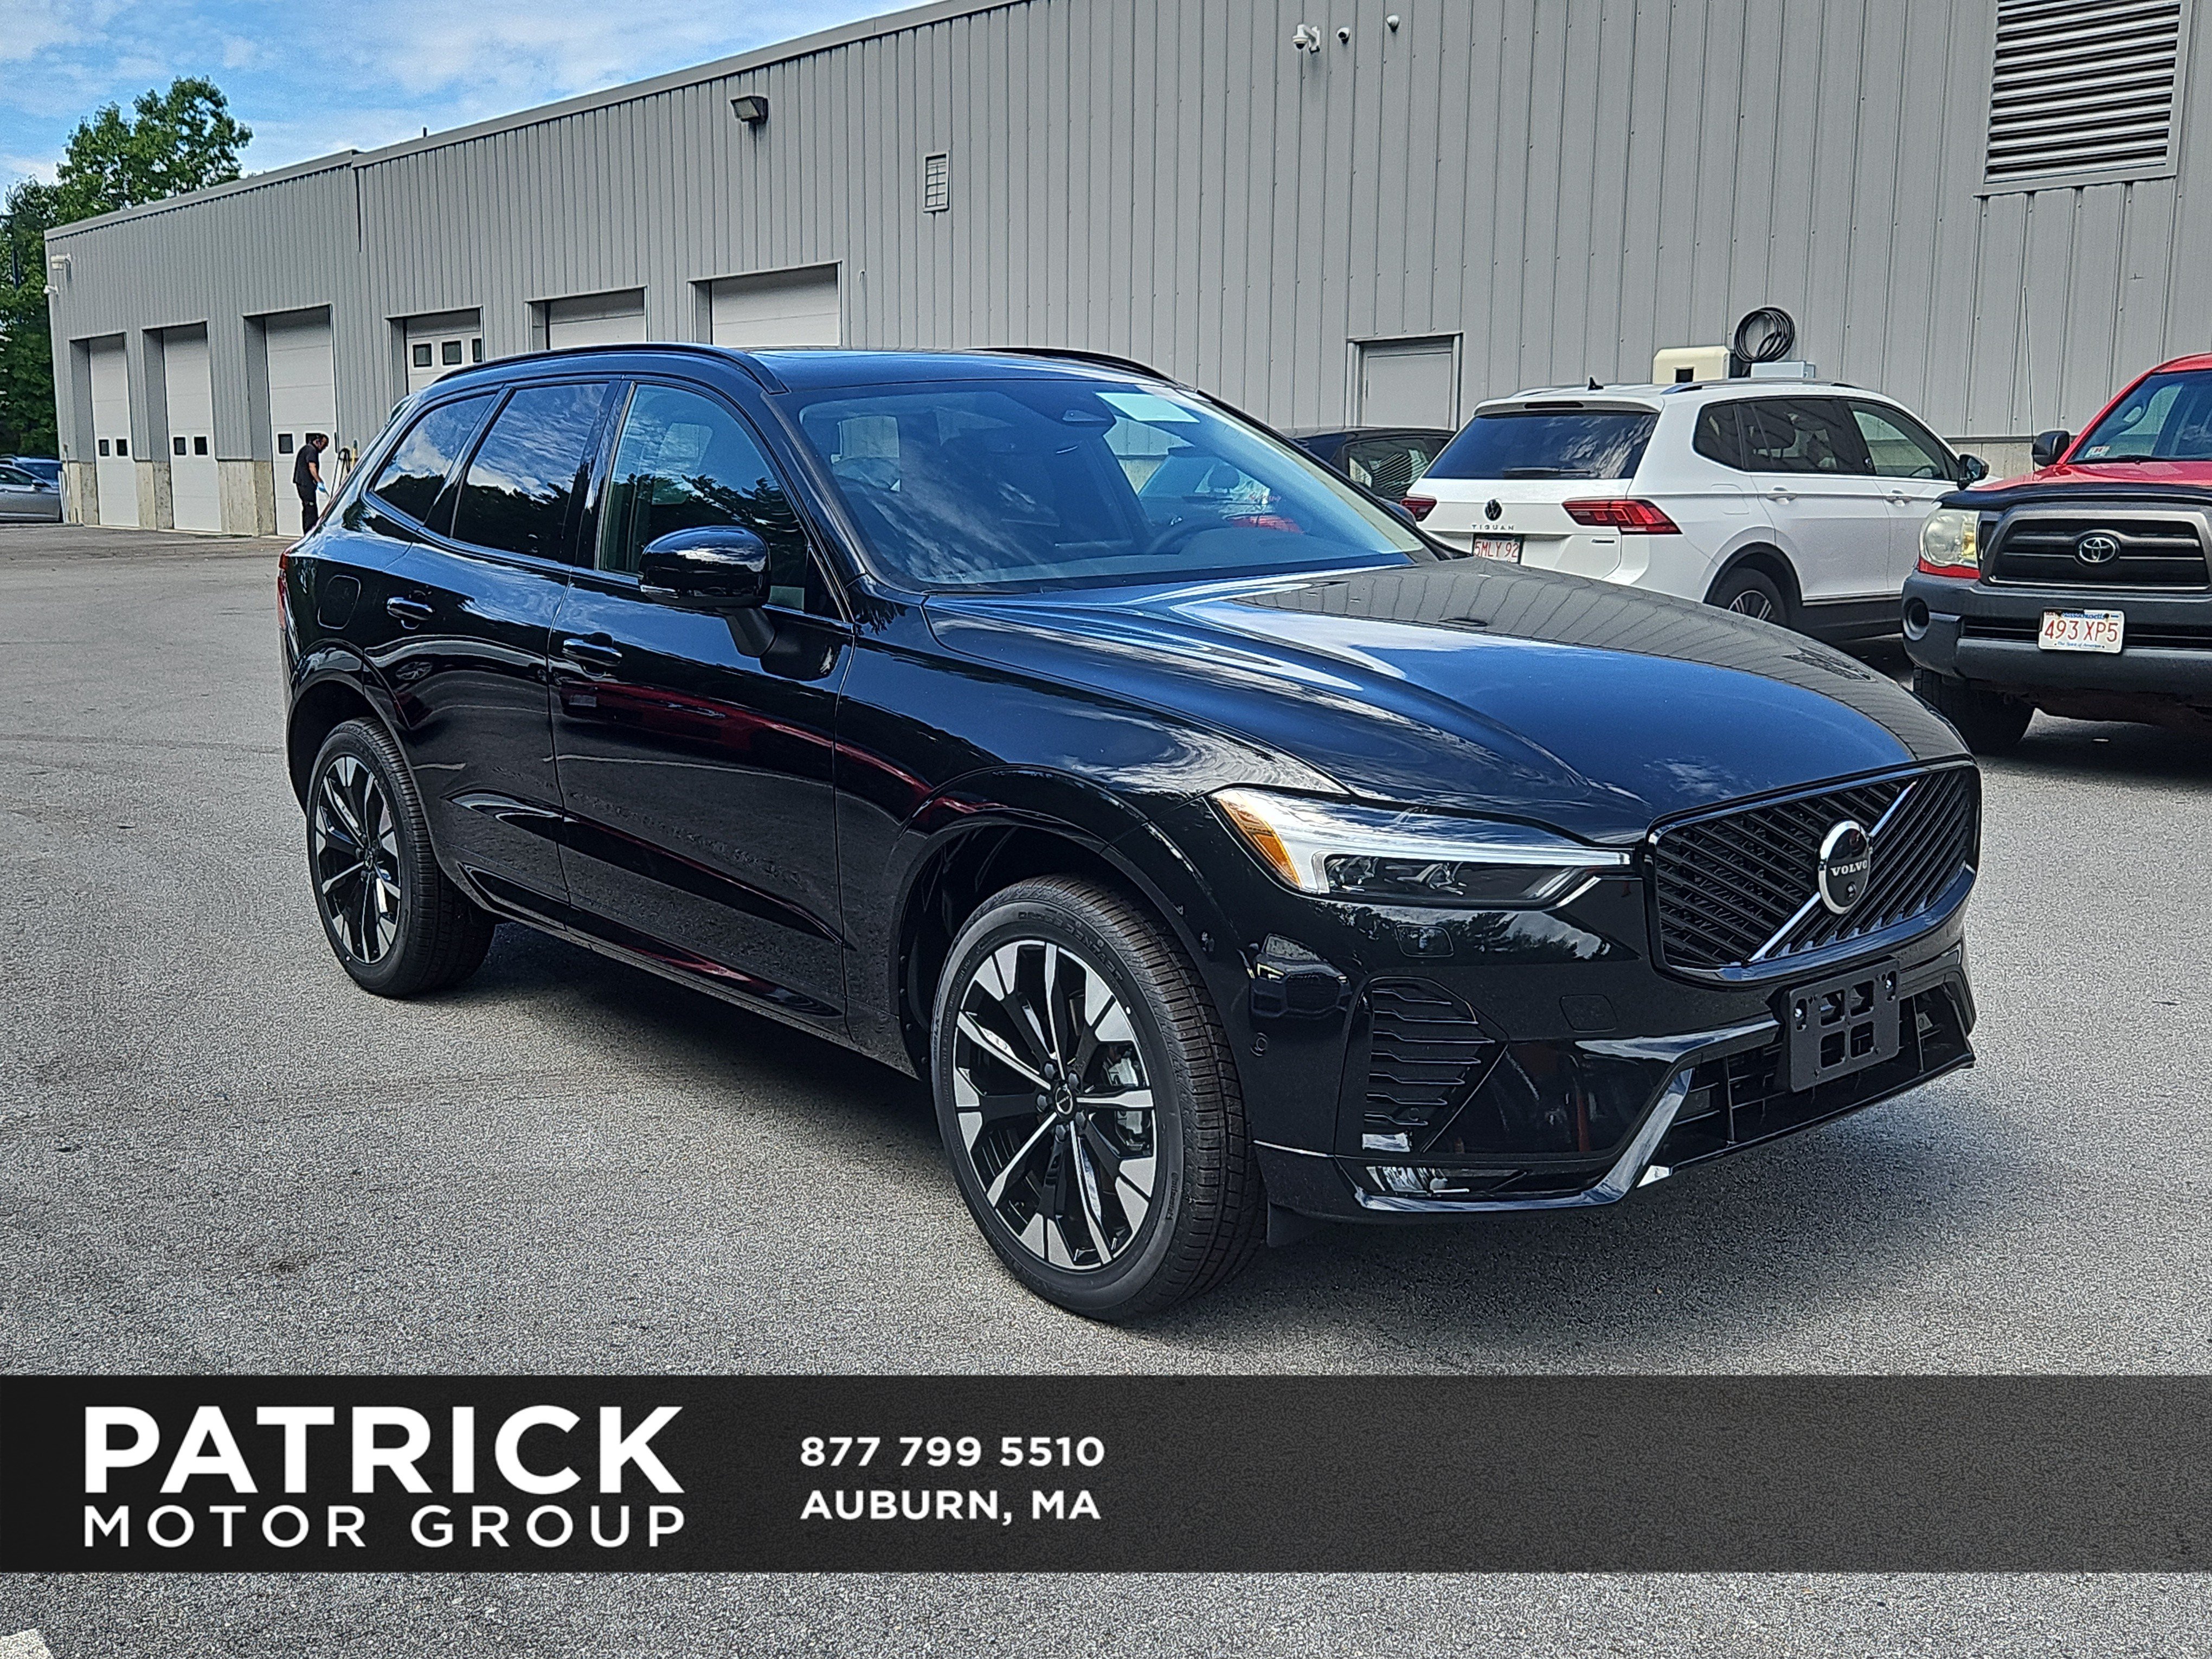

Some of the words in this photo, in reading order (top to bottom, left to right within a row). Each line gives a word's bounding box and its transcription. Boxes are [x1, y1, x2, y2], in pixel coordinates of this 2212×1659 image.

[1504, 542, 1520, 558] 92
[2044, 619, 2079, 640] 493
[2084, 621, 2118, 642] XP5
[1830, 860, 1868, 876] VOLVO
